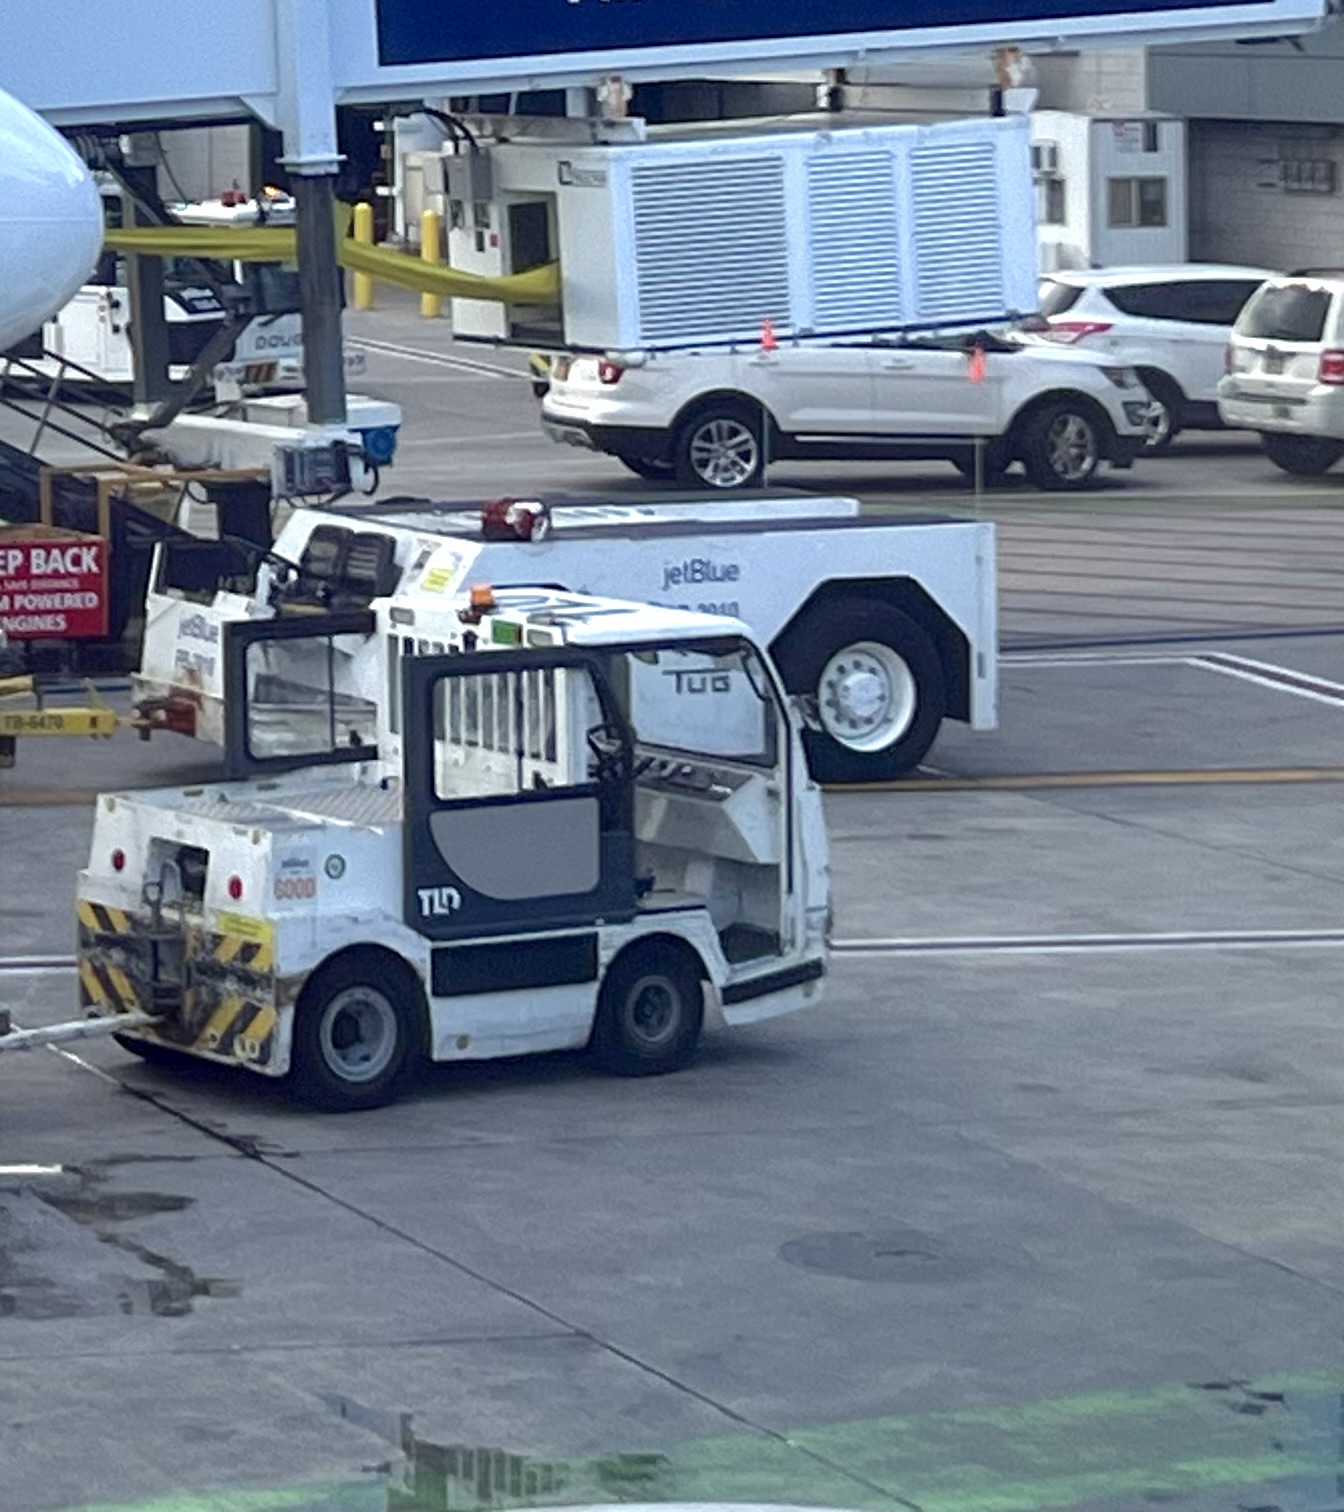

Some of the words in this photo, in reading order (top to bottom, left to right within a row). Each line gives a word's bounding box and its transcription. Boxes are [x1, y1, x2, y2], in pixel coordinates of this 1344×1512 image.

[30, 546, 100, 575] BACK
[662, 558, 740, 592] jetBlue
[13, 591, 99, 611] POWERED
[417, 886, 462, 916] TLD
